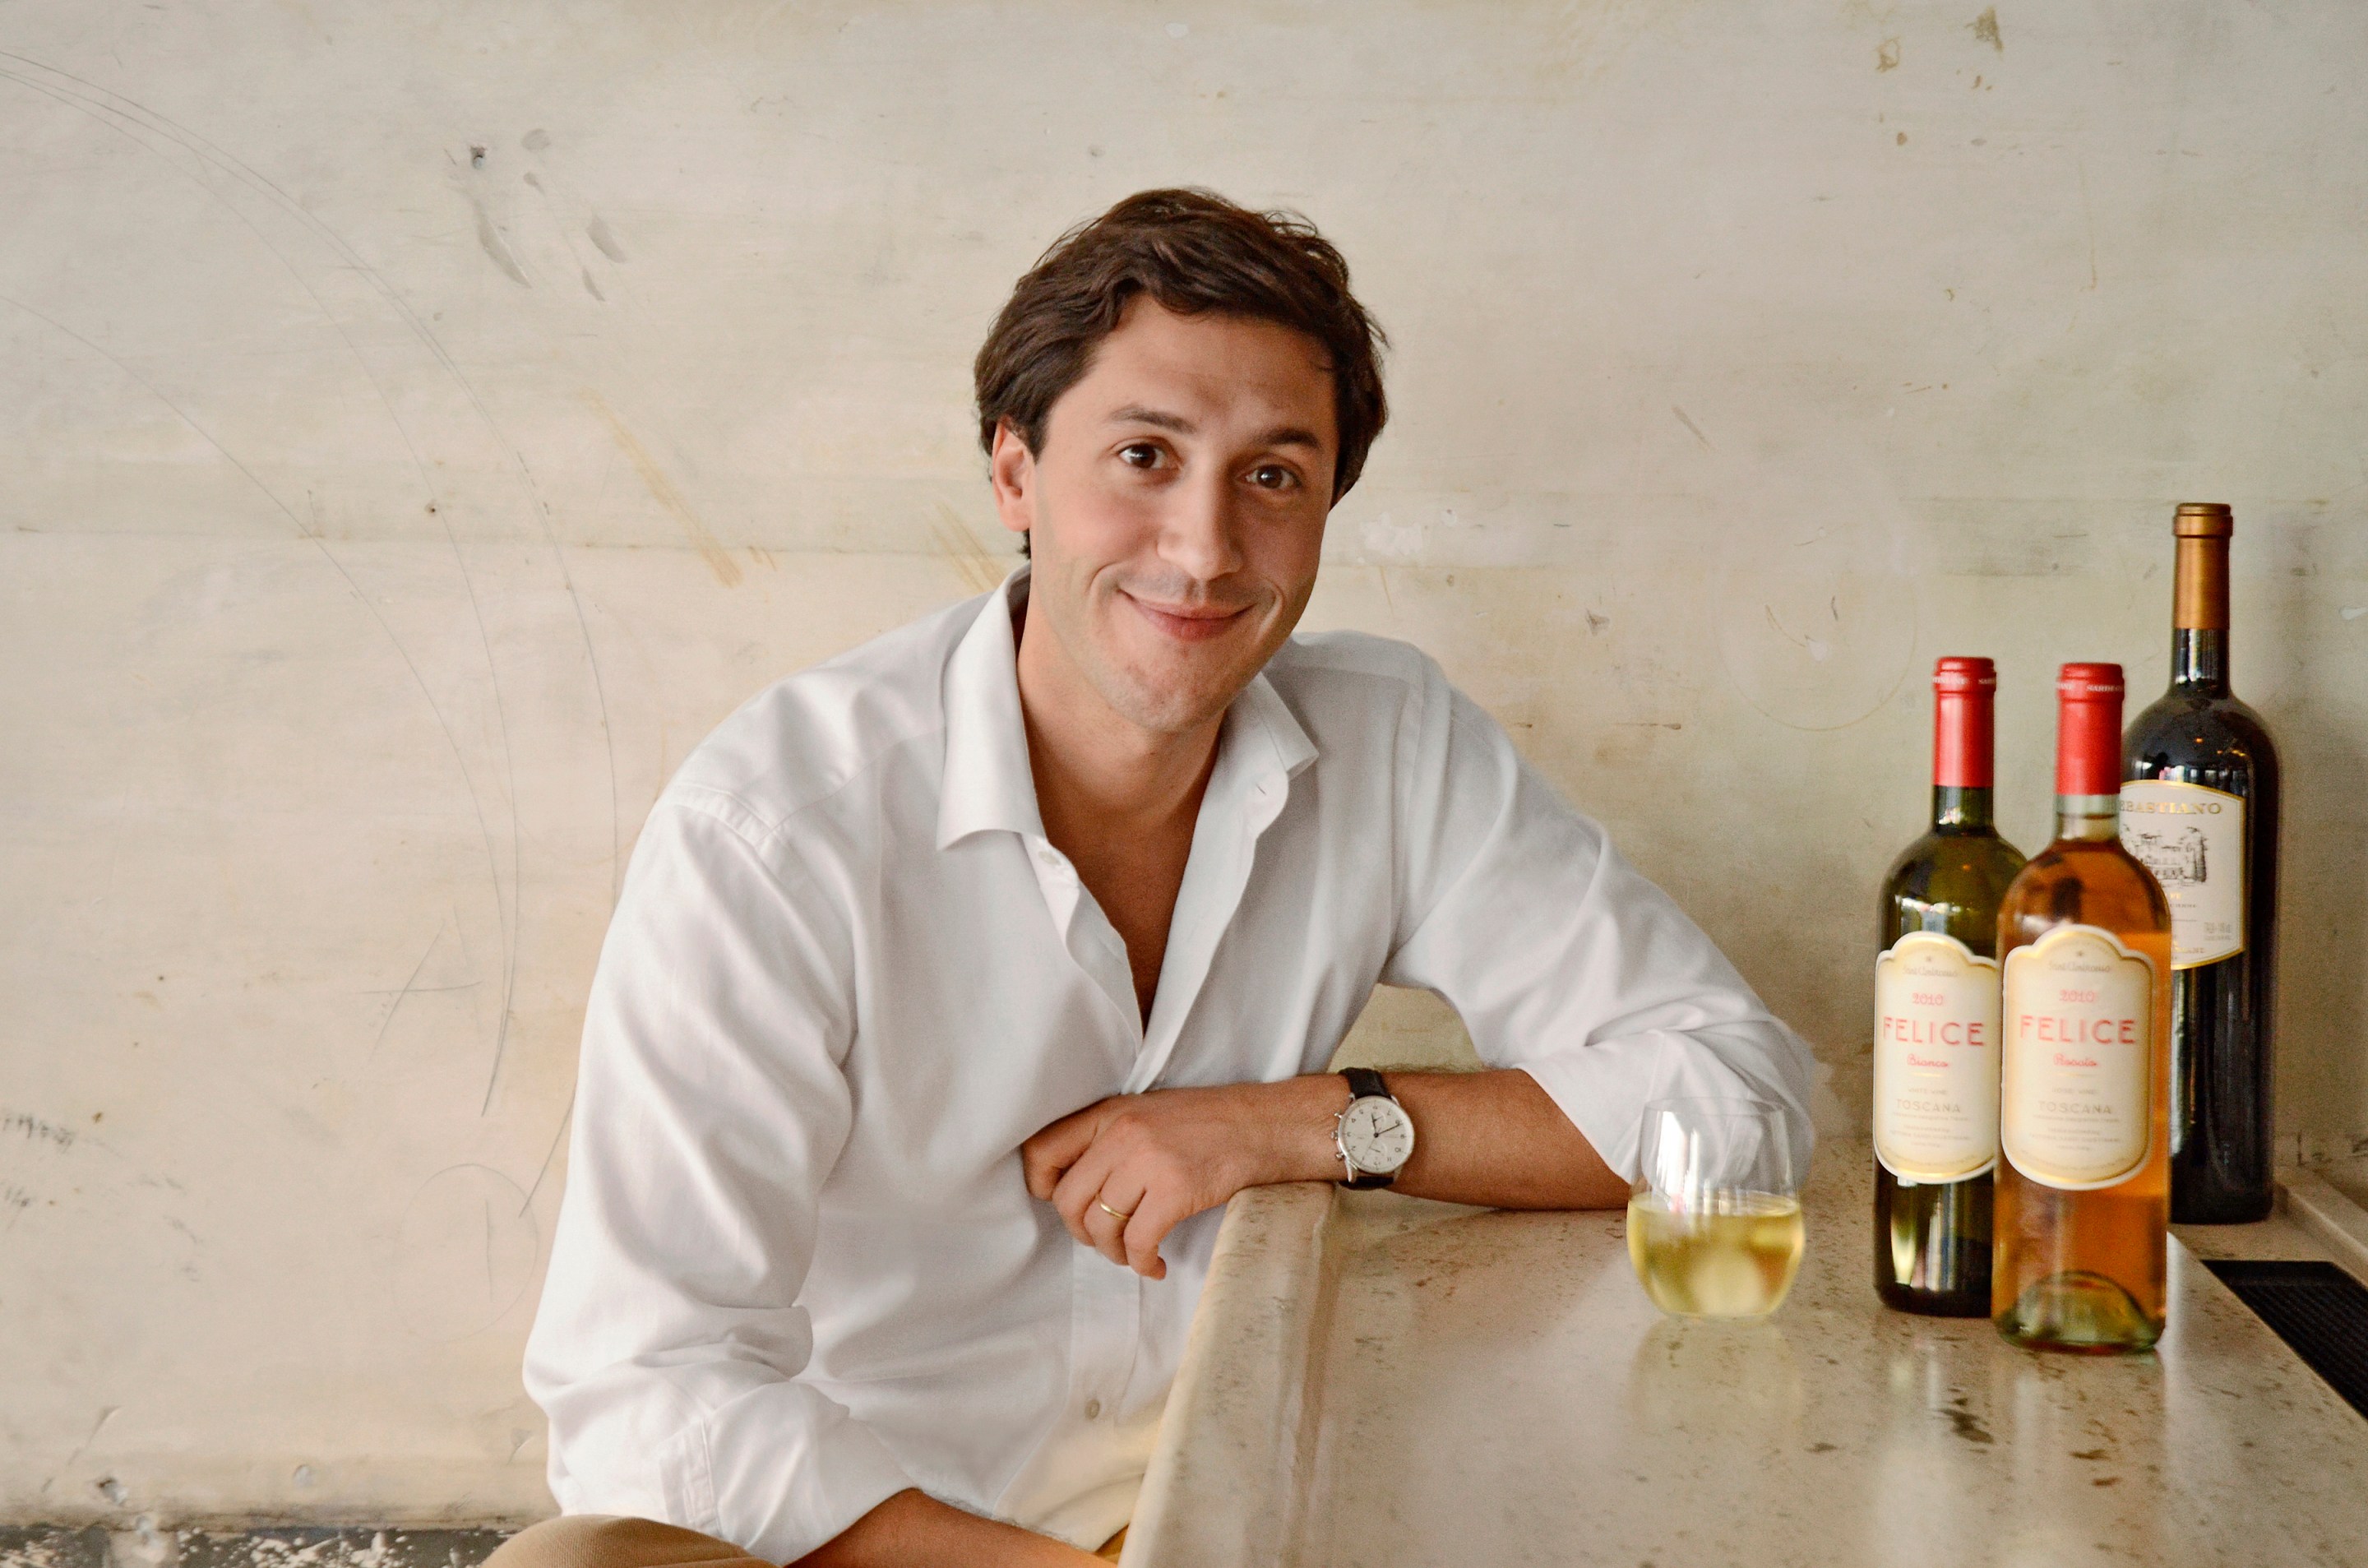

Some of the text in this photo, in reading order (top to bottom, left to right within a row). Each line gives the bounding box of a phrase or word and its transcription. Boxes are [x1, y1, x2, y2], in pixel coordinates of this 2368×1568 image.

[2119, 800, 2222, 815] EBASTIANO
[1912, 992, 1945, 1006] 2010
[2059, 989, 2096, 1003] 2010
[1882, 1016, 1986, 1047] FELICE
[2019, 1014, 2136, 1045] FELICE
[1895, 1098, 1962, 1113] TOSCANA
[2037, 1099, 2112, 1115] TOSCANA
